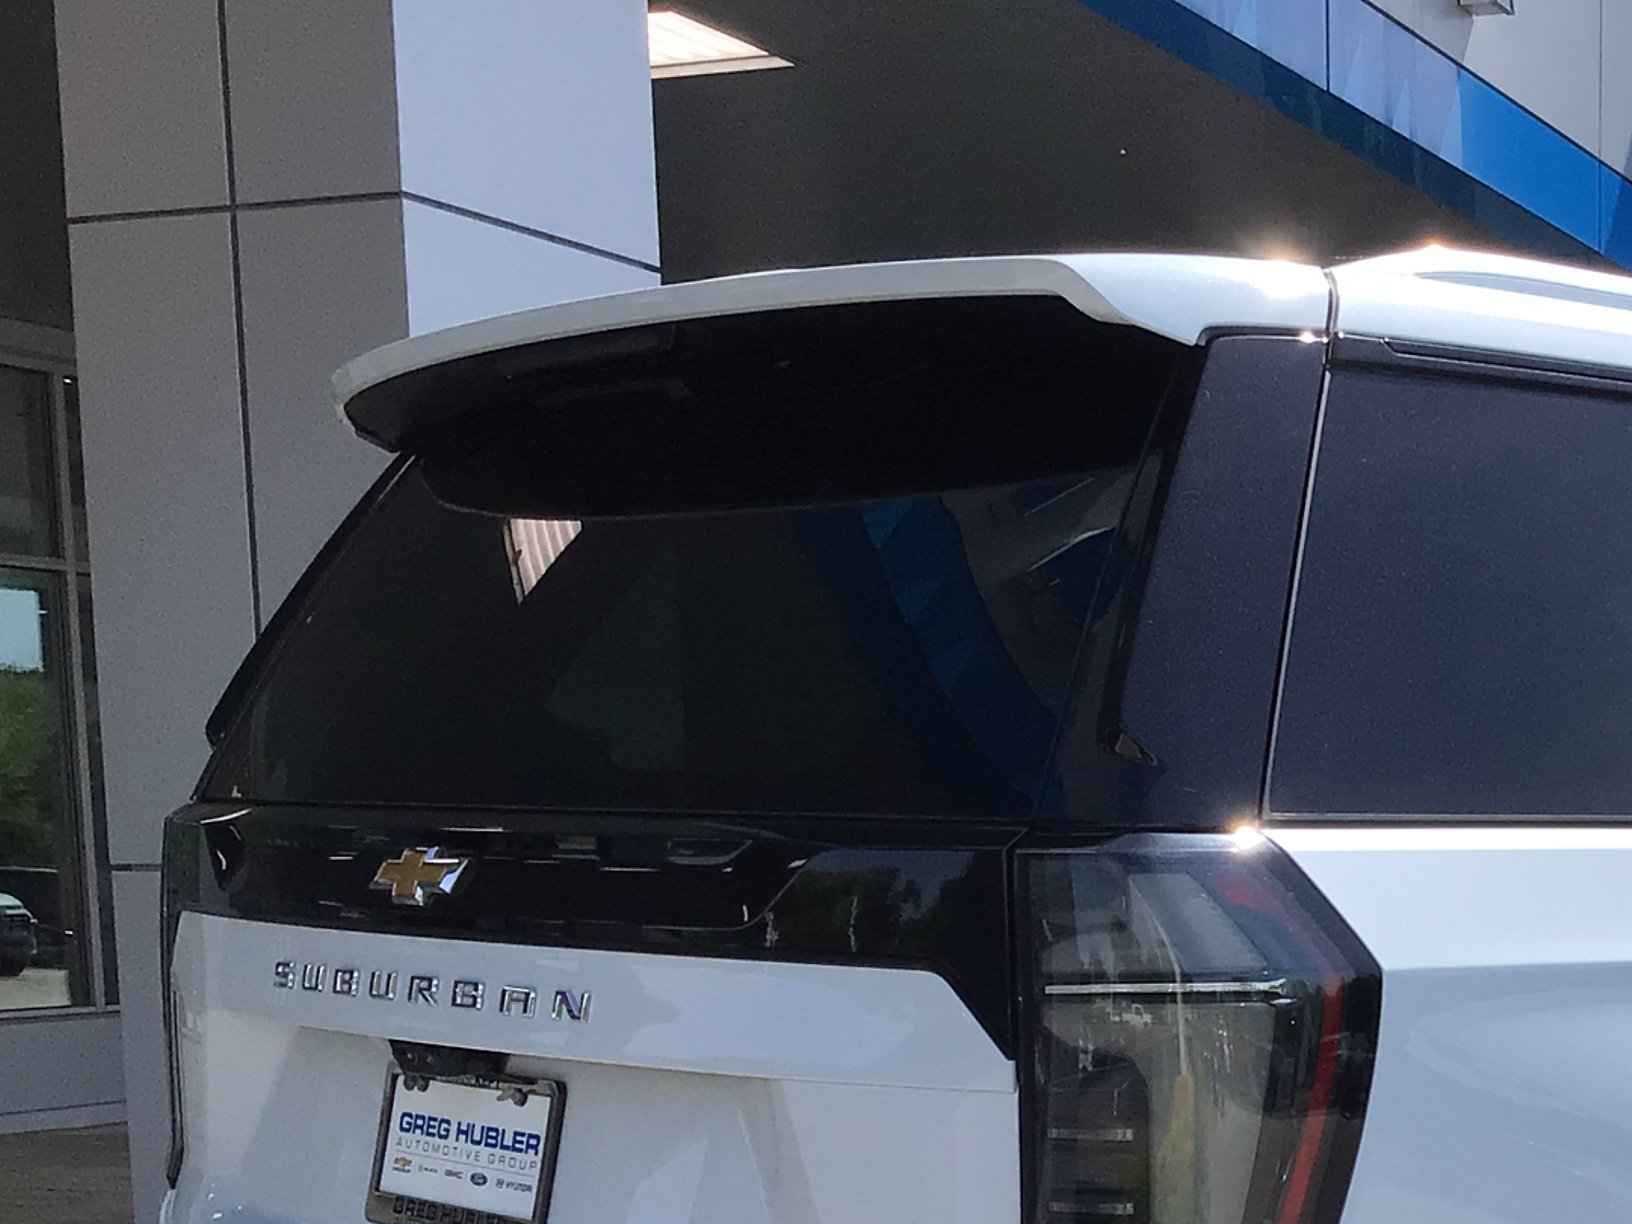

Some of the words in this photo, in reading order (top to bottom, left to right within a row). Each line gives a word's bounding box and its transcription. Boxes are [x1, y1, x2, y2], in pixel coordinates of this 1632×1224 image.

[273, 960, 592, 1022] SUBURBAN
[399, 1111, 451, 1141] GREG
[455, 1121, 541, 1156] HUBLER
[396, 1138, 481, 1162] AUTOMOTIVE
[487, 1153, 539, 1171] GROUP
[393, 1197, 438, 1222] GREG
